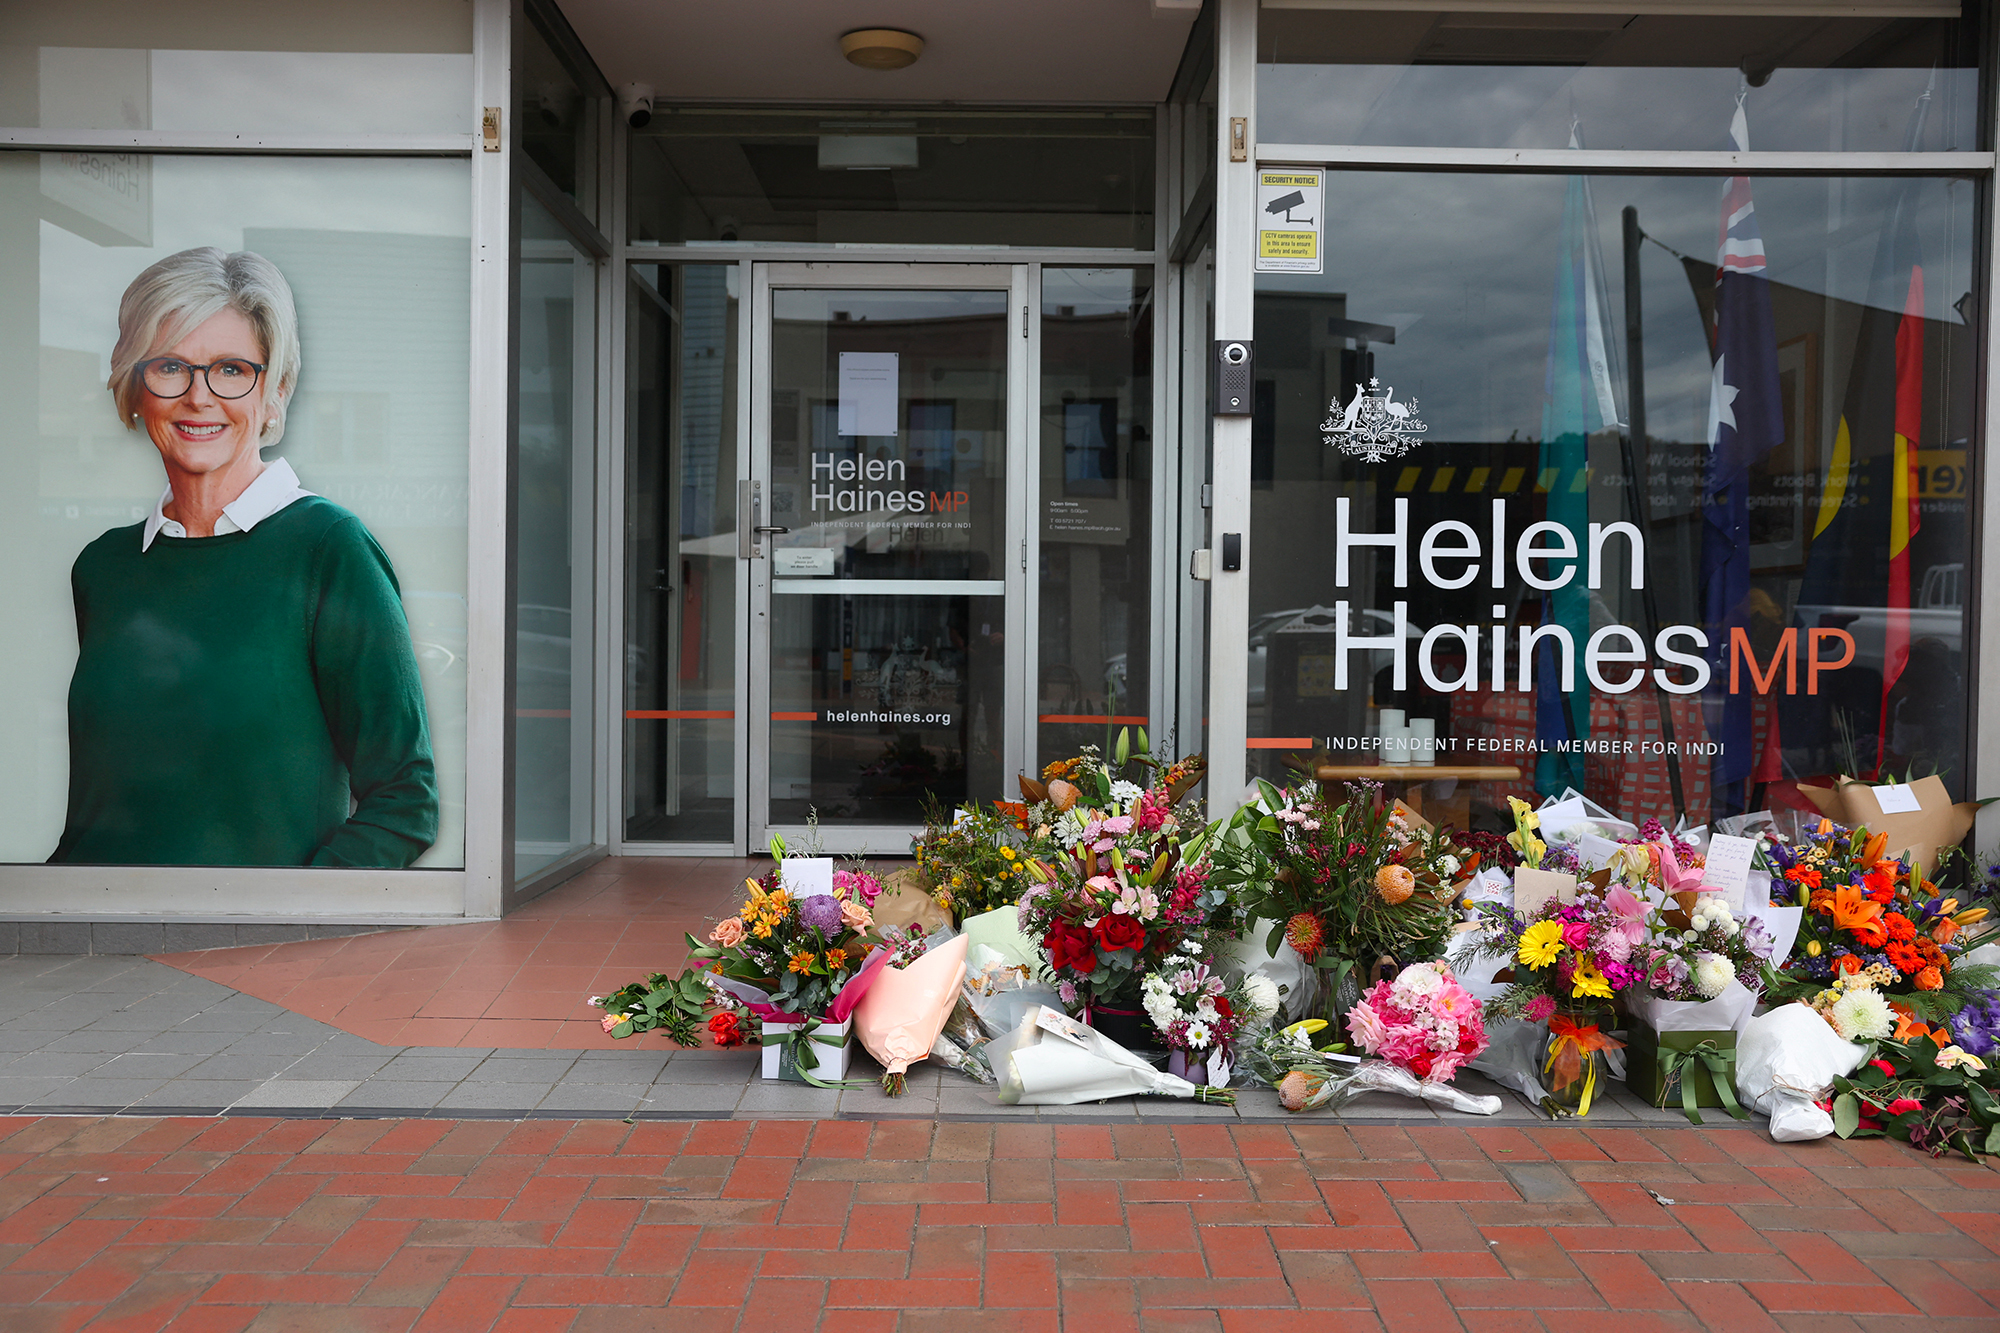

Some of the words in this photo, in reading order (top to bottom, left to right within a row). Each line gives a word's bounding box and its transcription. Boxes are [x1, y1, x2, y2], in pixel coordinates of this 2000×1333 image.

[1264, 176, 1292, 184] SECURITY
[1354, 444, 1392, 454] AUSTRALIA
[812, 452, 905, 481] Helen
[812, 484, 925, 512] Haines
[930, 492, 969, 512] MP
[889, 526, 944, 542] Helen
[1336, 498, 1644, 590] Helen
[1334, 600, 1710, 694] Haines
[1730, 628, 1856, 694] MP
[826, 710, 951, 726] helenhaines.org
[1326, 736, 1458, 750] INDEPENDENT
[1466, 738, 1548, 752] FEDERAL
[1557, 740, 1633, 754] MEMBER
[1642, 742, 1677, 755] FOR
[1686, 742, 1724, 756] INDI
